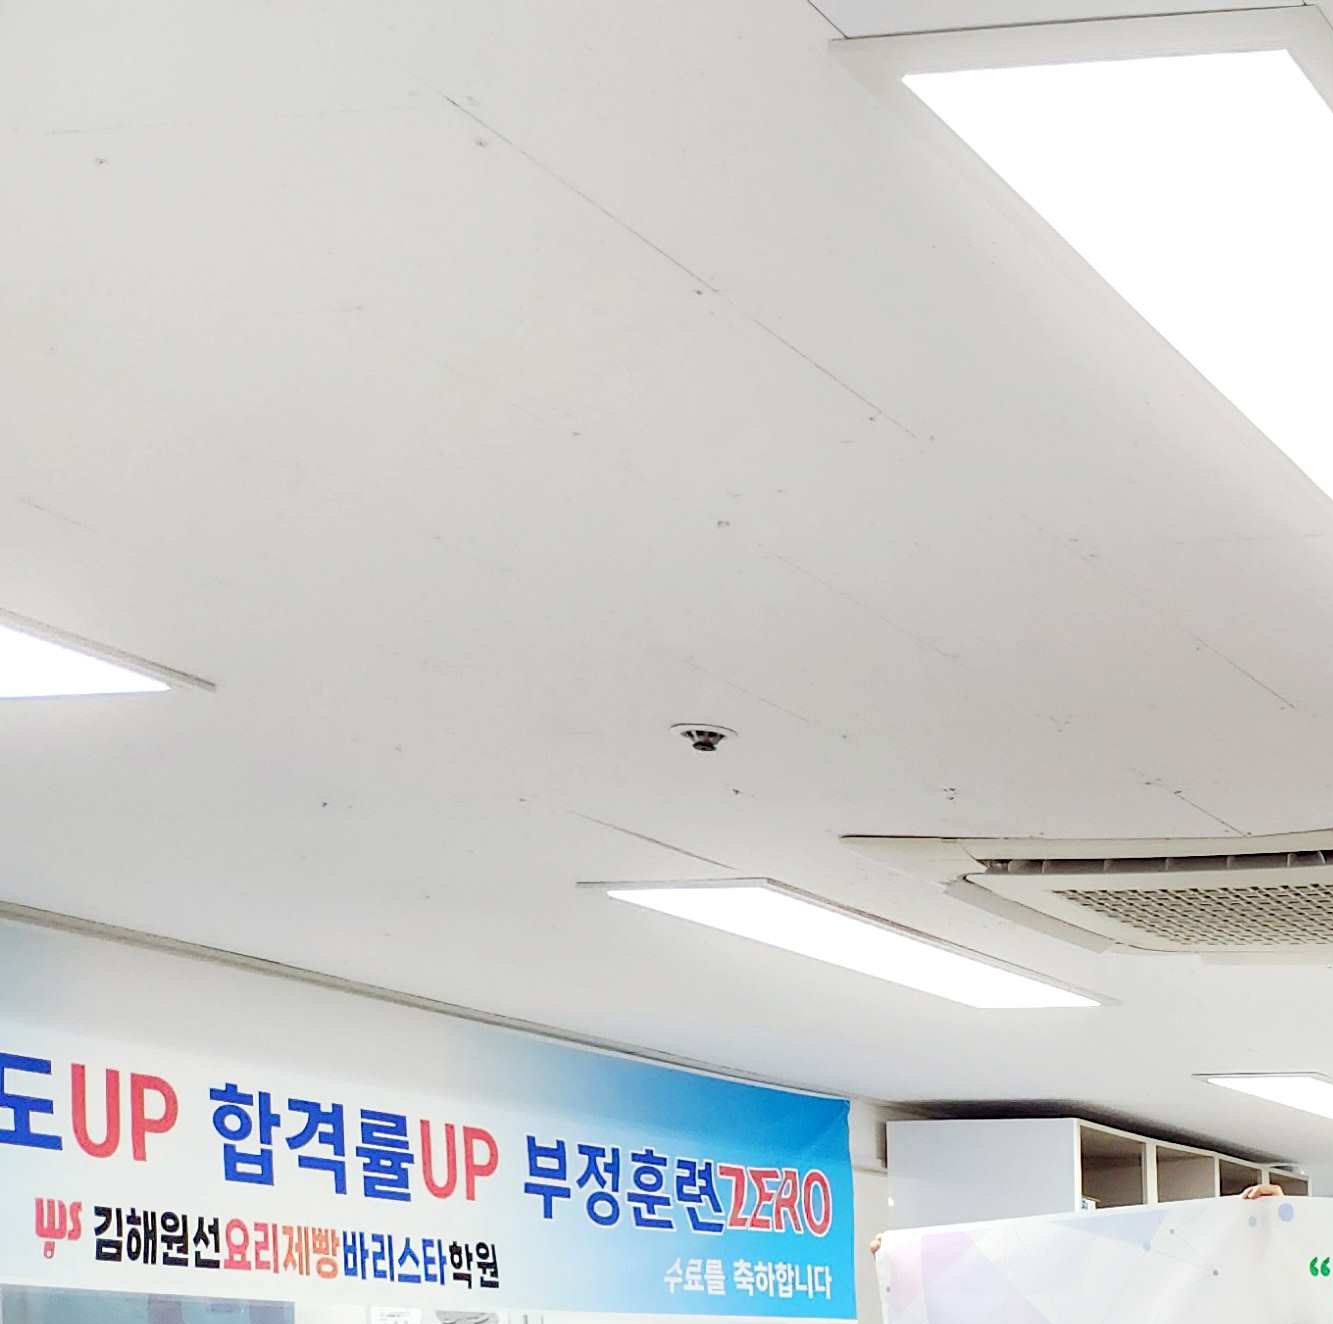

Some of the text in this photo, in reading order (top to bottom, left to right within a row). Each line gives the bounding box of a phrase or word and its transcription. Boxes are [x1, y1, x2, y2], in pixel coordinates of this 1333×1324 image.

[209, 1082, 499, 1202] 합격률UP
[523, 1134, 833, 1236] 부정훈련ZERO
[94, 1204, 500, 1289] 김해원선요리제빵바리스타학원
[664, 1257, 833, 1300] 수료를 축하합니다
